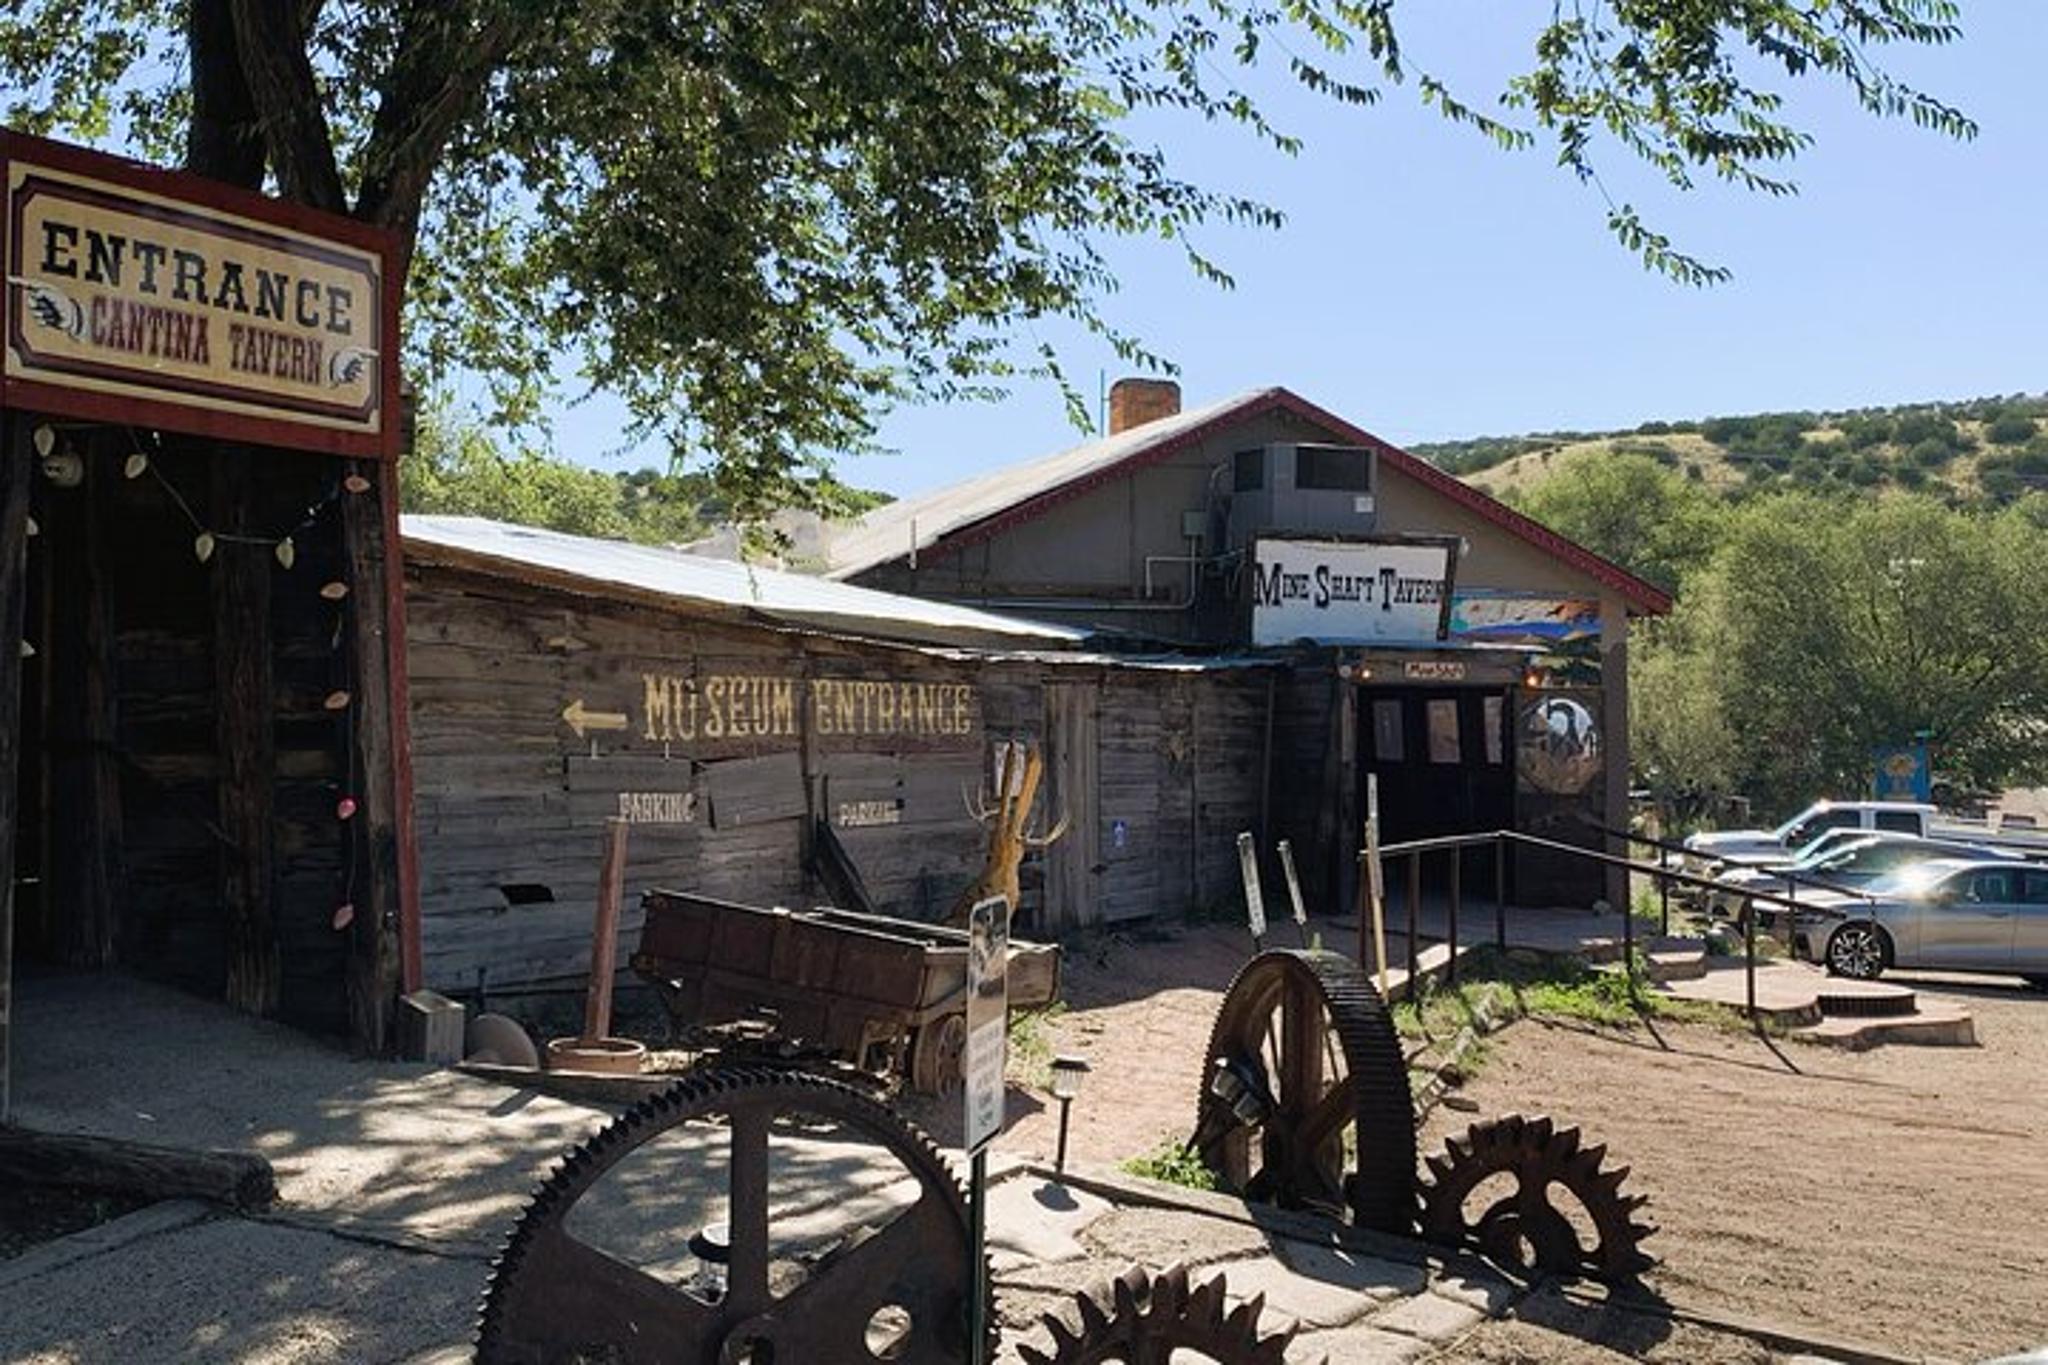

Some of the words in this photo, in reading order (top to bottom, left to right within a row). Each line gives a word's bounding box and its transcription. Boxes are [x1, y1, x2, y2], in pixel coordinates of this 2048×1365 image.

[41, 220, 354, 335] ENTRANCE
[89, 295, 210, 366] CANTINA
[228, 322, 324, 385] TAVERN
[643, 673, 794, 741] MUSEUM
[812, 677, 971, 736] ENTRANCE
[618, 792, 695, 824] PARKING
